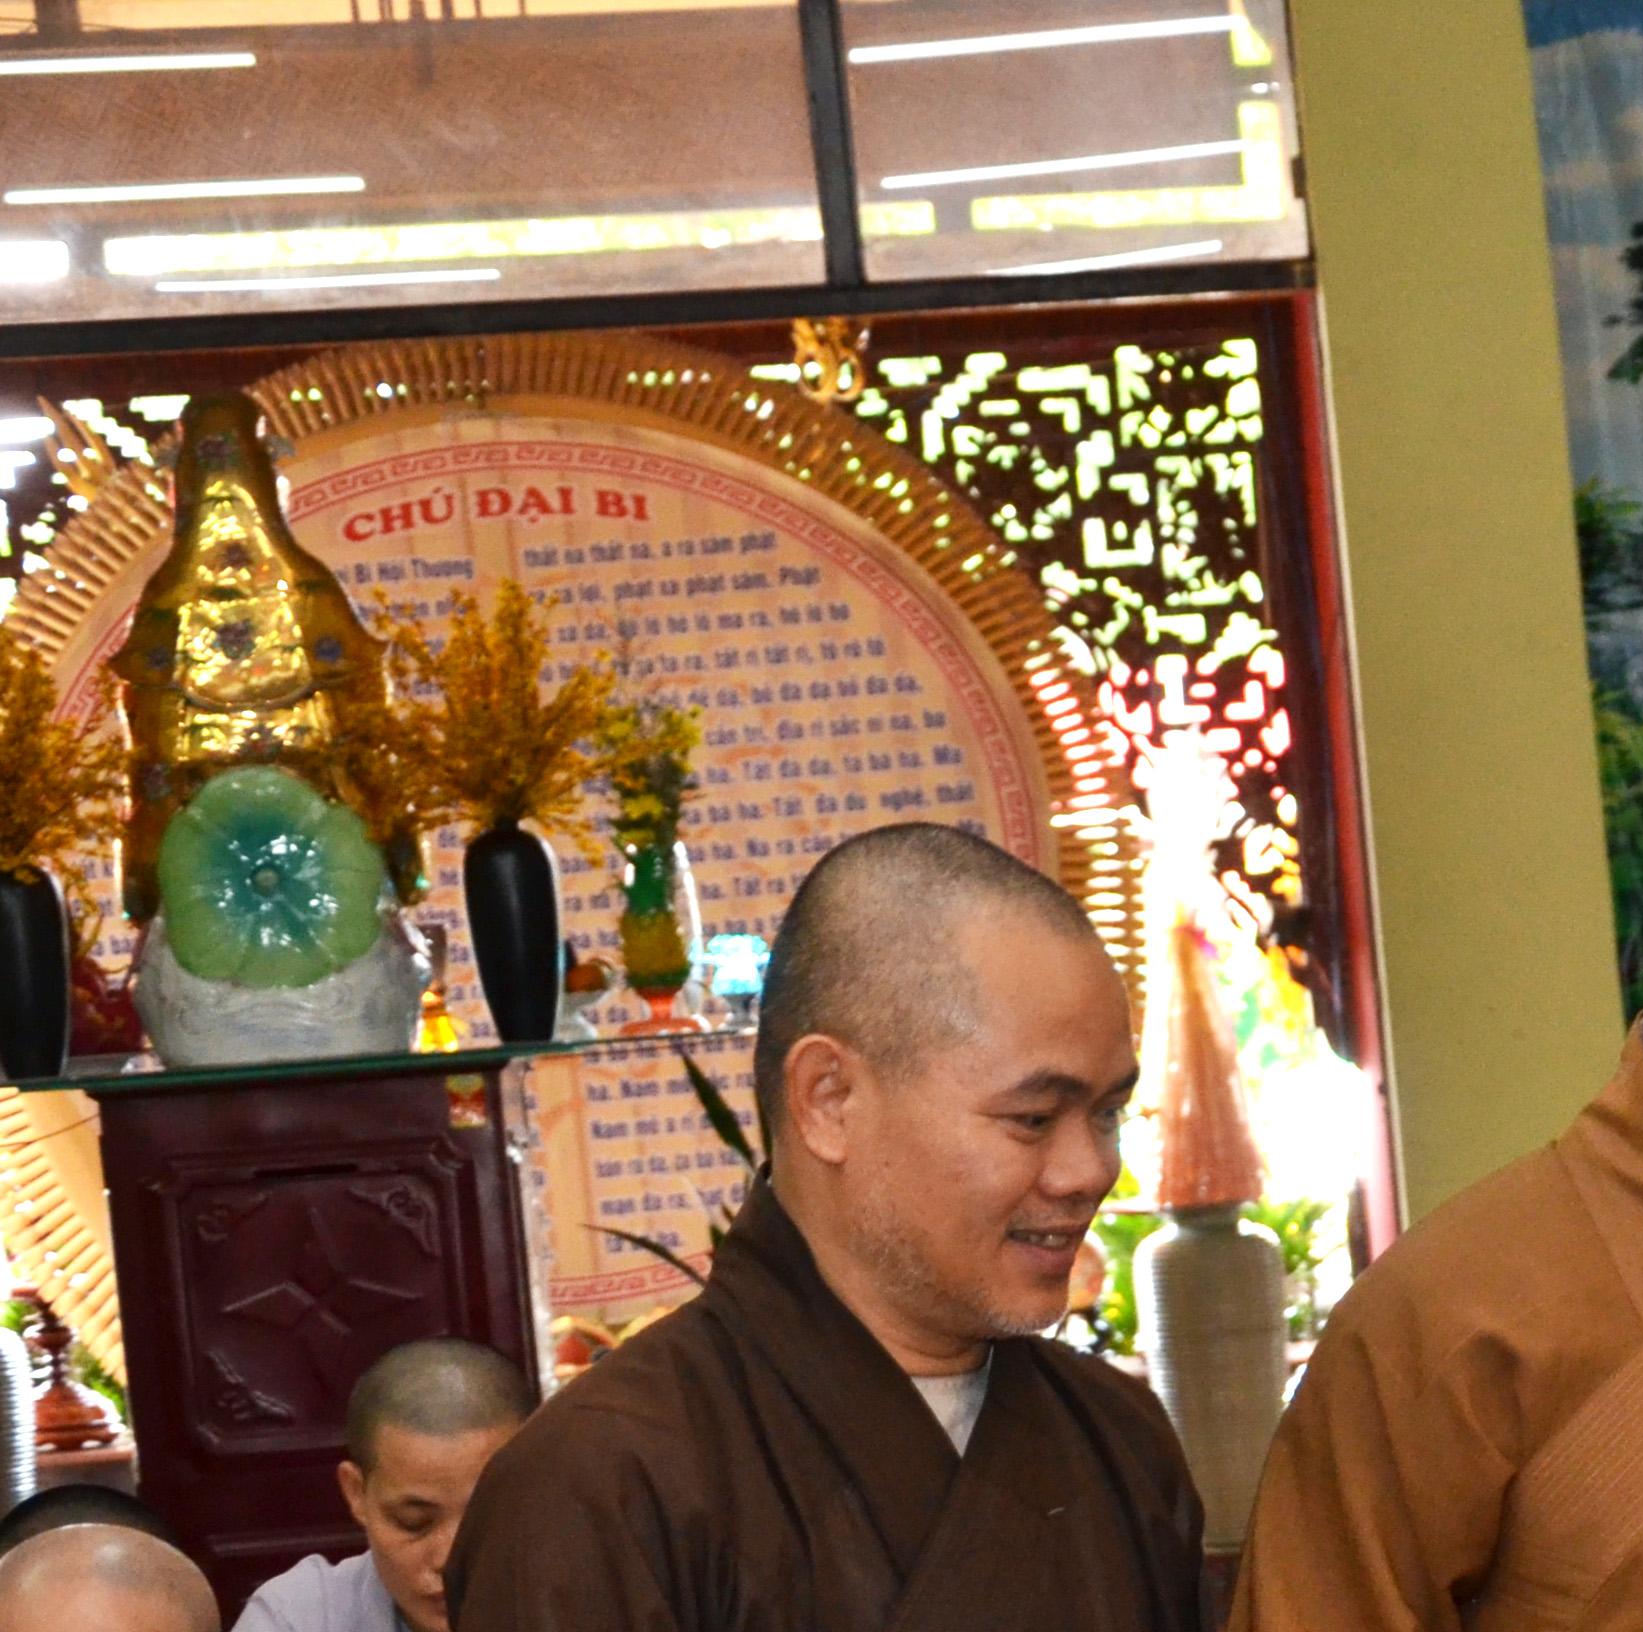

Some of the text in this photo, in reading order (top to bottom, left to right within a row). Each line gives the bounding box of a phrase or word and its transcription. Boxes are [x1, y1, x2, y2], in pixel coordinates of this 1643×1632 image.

[343, 485, 650, 543] CHÚ ĐẠI BI
